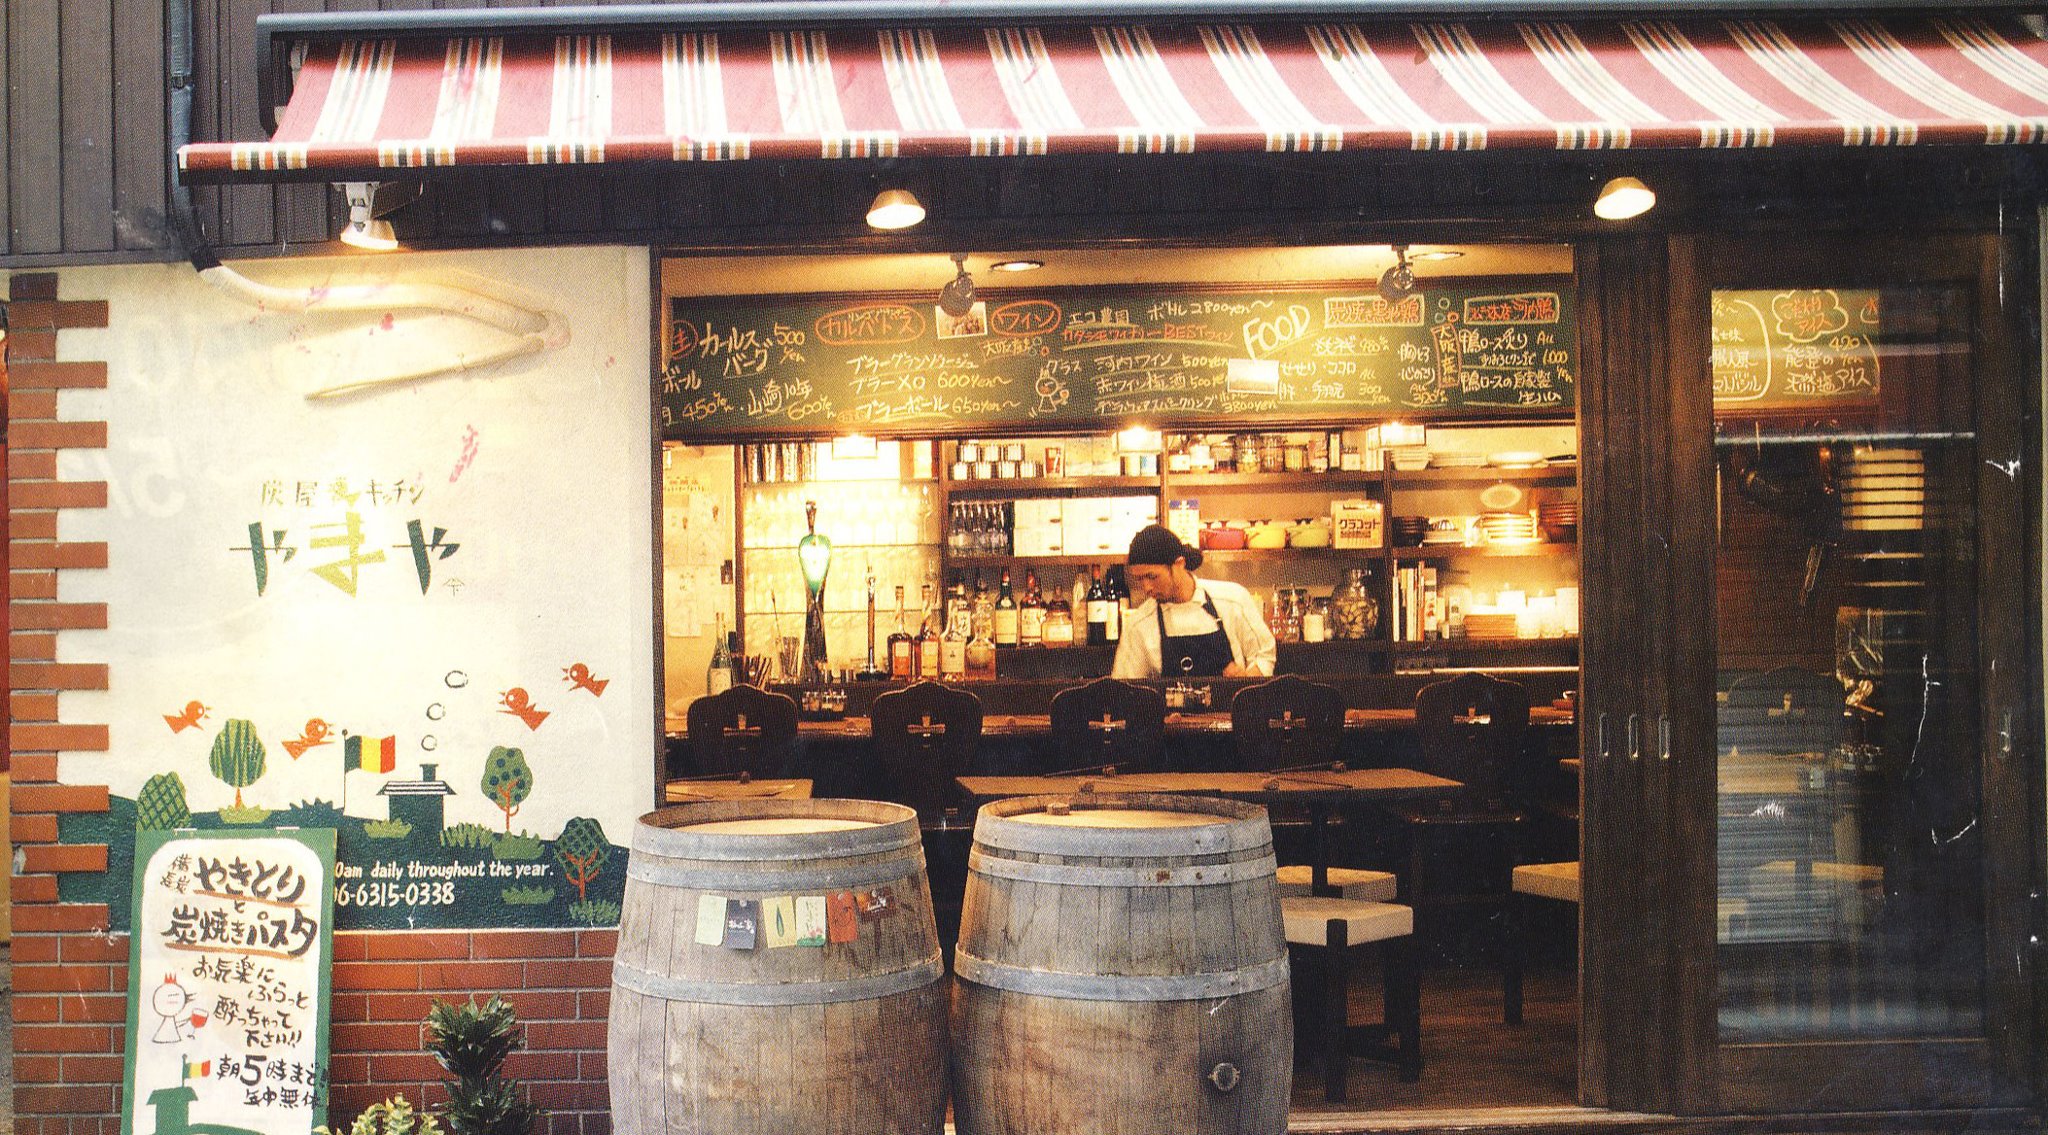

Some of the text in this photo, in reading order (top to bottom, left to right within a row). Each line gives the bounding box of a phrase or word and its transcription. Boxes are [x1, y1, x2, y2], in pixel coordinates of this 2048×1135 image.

[774, 322, 805, 346] 500
[1243, 303, 1310, 361] FOOD
[192, 856, 306, 904] やきとり
[370, 860, 404, 881] daily
[407, 860, 486, 880] throughout
[489, 860, 512, 877] the
[515, 863, 554, 879] year.
[160, 904, 318, 957] 炭焼きパスタ
[192, 954, 276, 984] お気楽に
